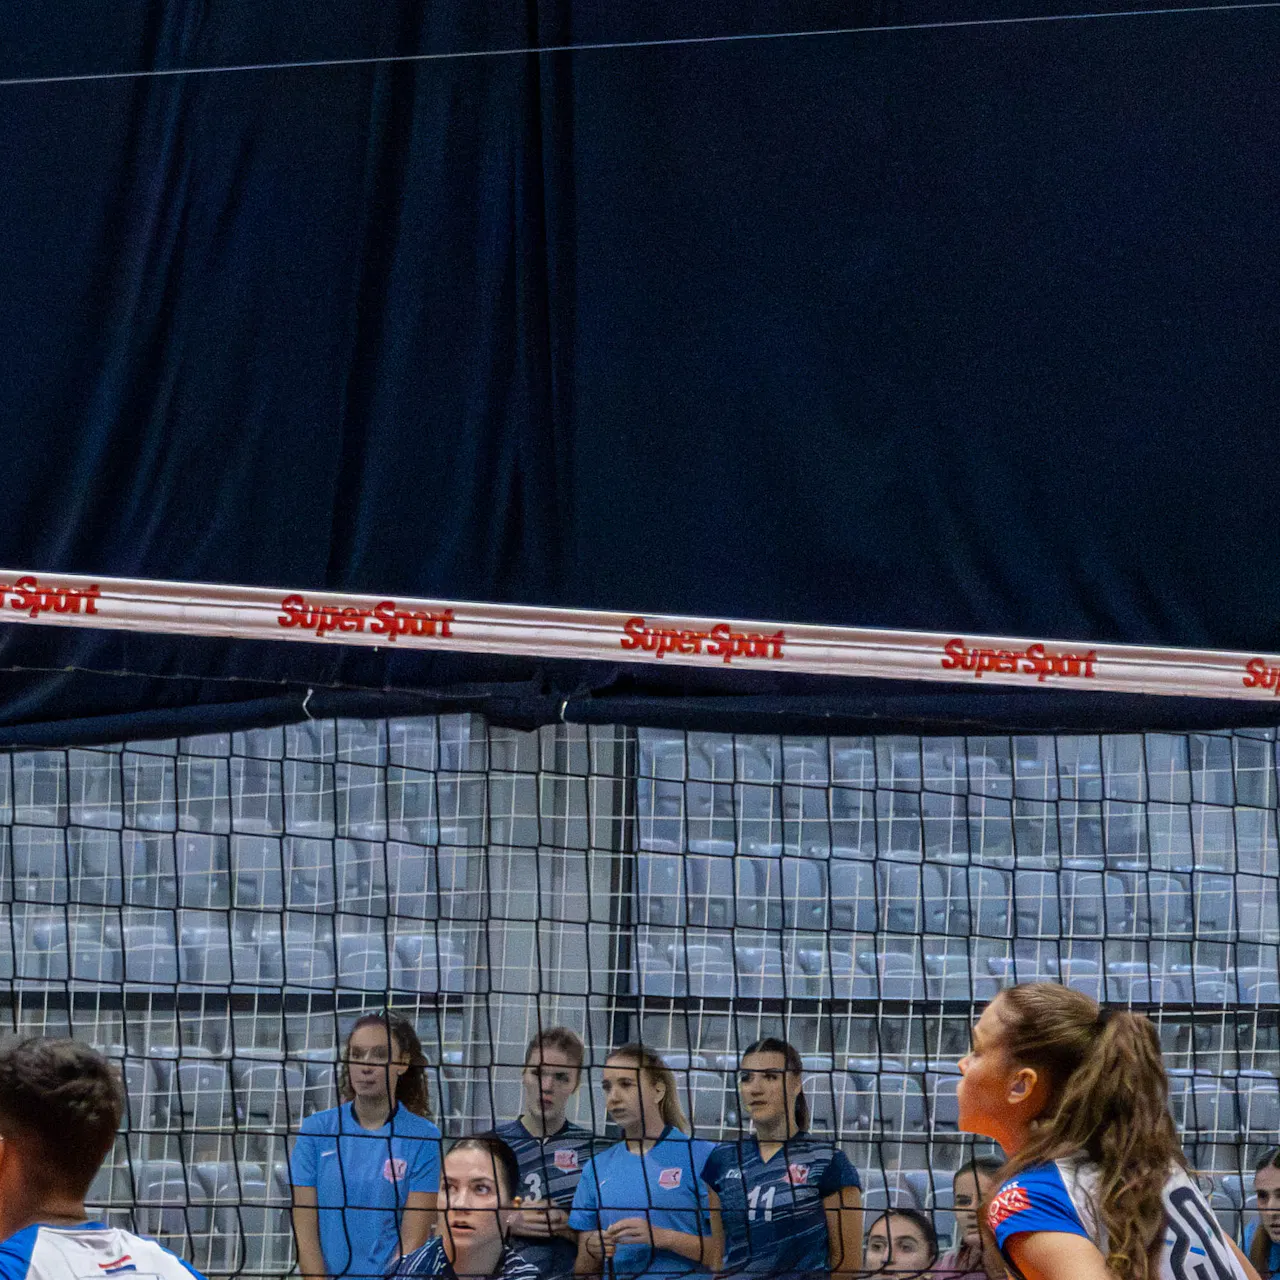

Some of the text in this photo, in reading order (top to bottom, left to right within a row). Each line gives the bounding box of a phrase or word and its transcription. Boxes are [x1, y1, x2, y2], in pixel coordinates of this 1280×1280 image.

[277, 594, 454, 642] SuperSport
[620, 617, 786, 663] SuperSport
[941, 638, 1097, 683] SuperSport
[524, 1173, 542, 1202] 3
[747, 1186, 776, 1222] 11
